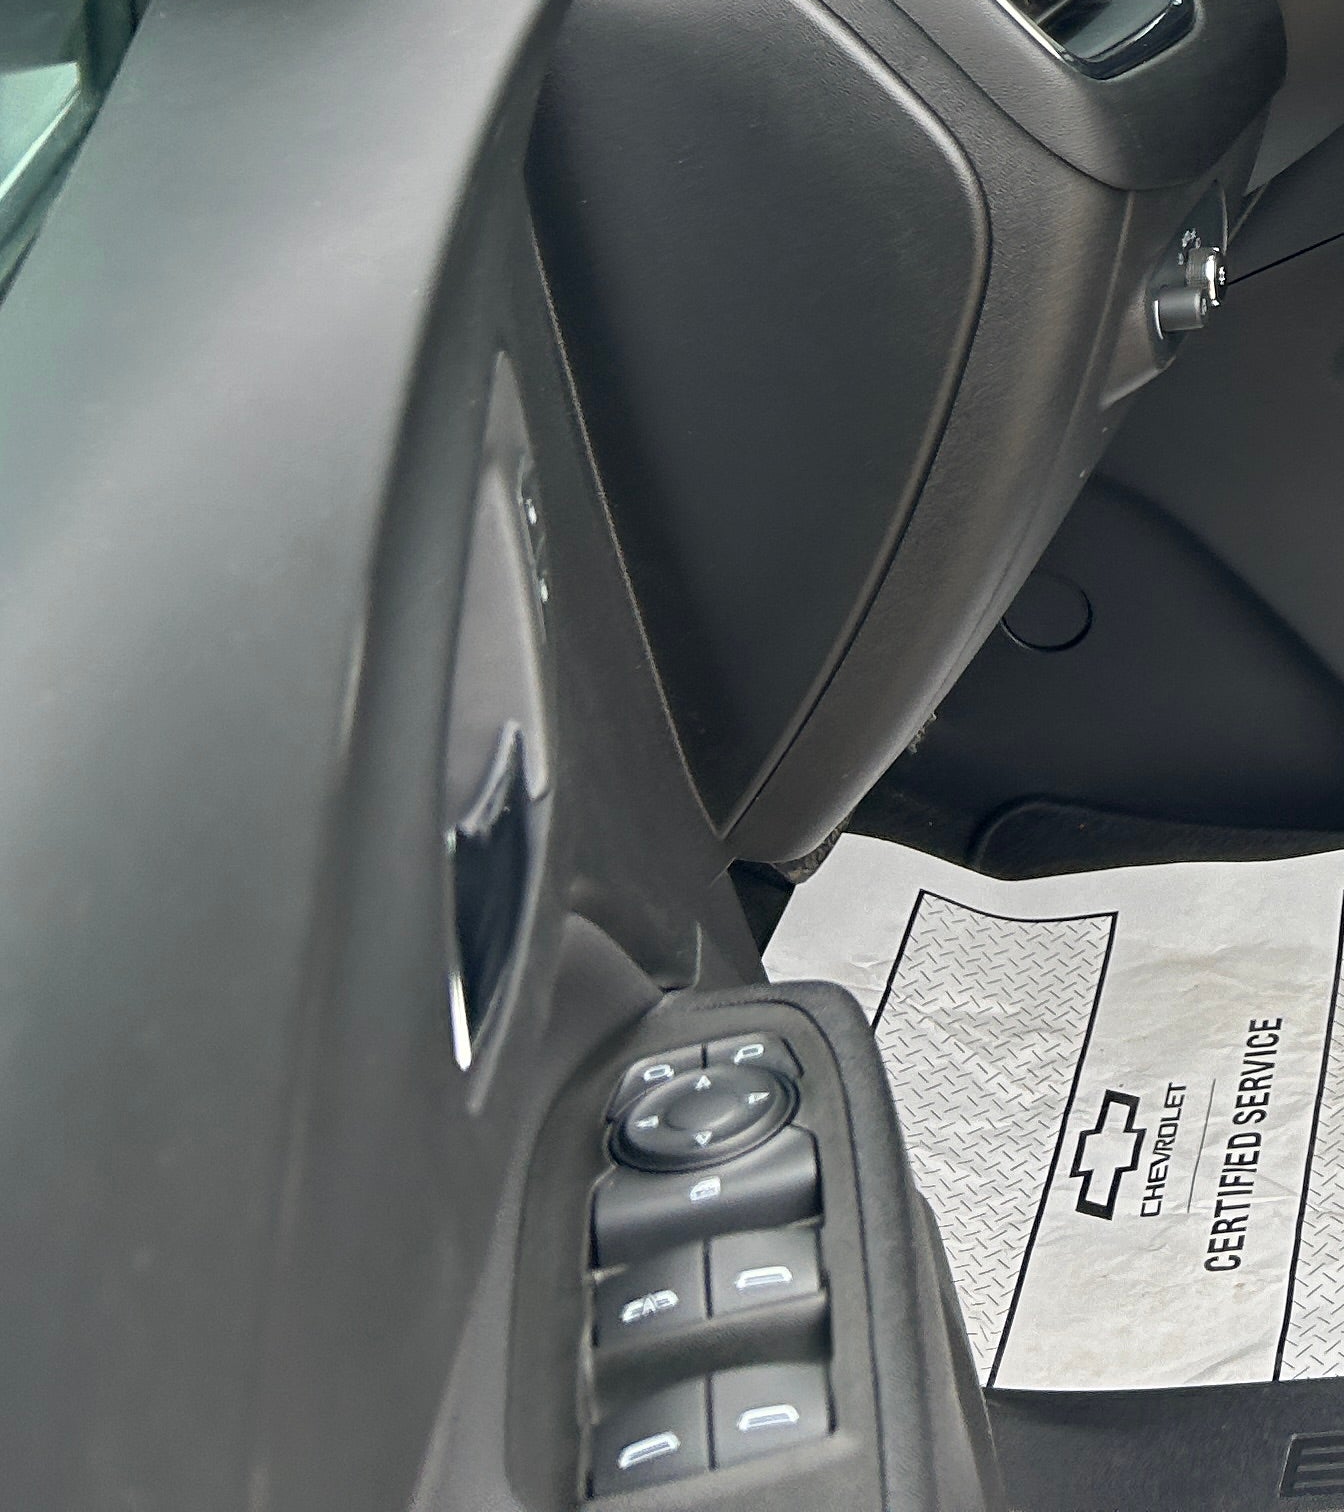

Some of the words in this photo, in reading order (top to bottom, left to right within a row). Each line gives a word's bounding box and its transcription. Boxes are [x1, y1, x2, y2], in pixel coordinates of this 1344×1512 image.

[1232, 1017, 1283, 1125] SERVICE
[1139, 1081, 1187, 1218] CHEVROLET
[1203, 1131, 1263, 1273] CERTIFIED
